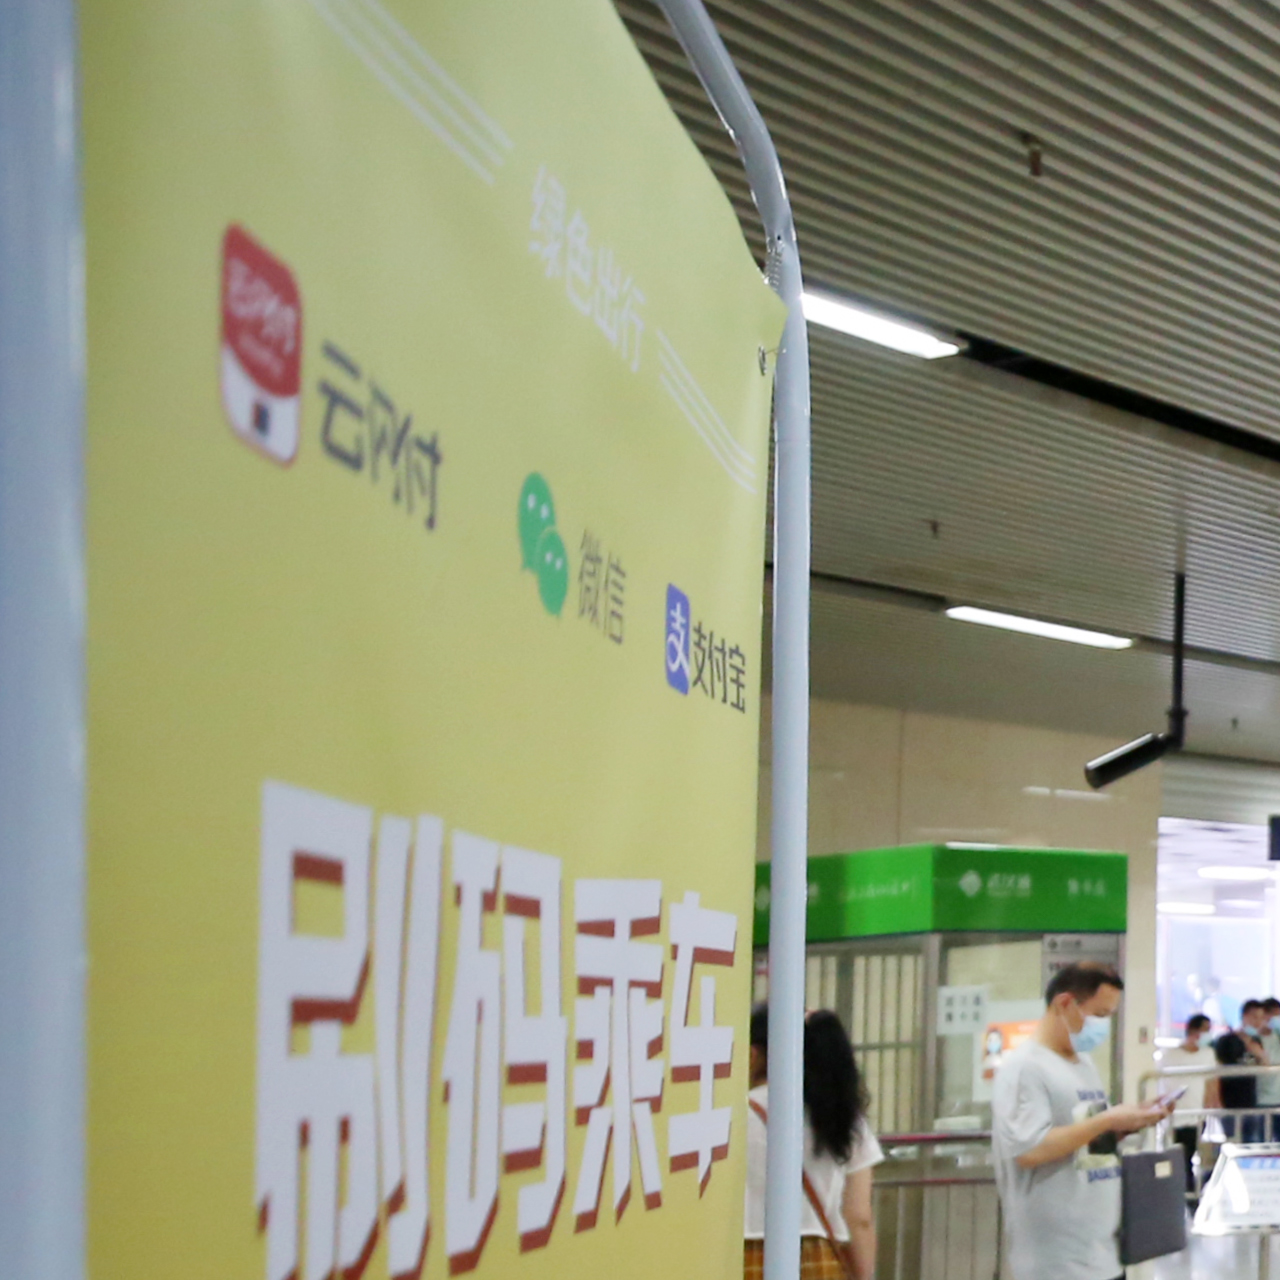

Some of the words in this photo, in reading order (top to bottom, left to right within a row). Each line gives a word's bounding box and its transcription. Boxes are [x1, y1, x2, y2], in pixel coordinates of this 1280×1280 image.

[528, 164, 646, 373] 绿色出行
[318, 338, 442, 531] 云闪付
[579, 528, 627, 645] 微信
[692, 621, 745, 714] 支付宝
